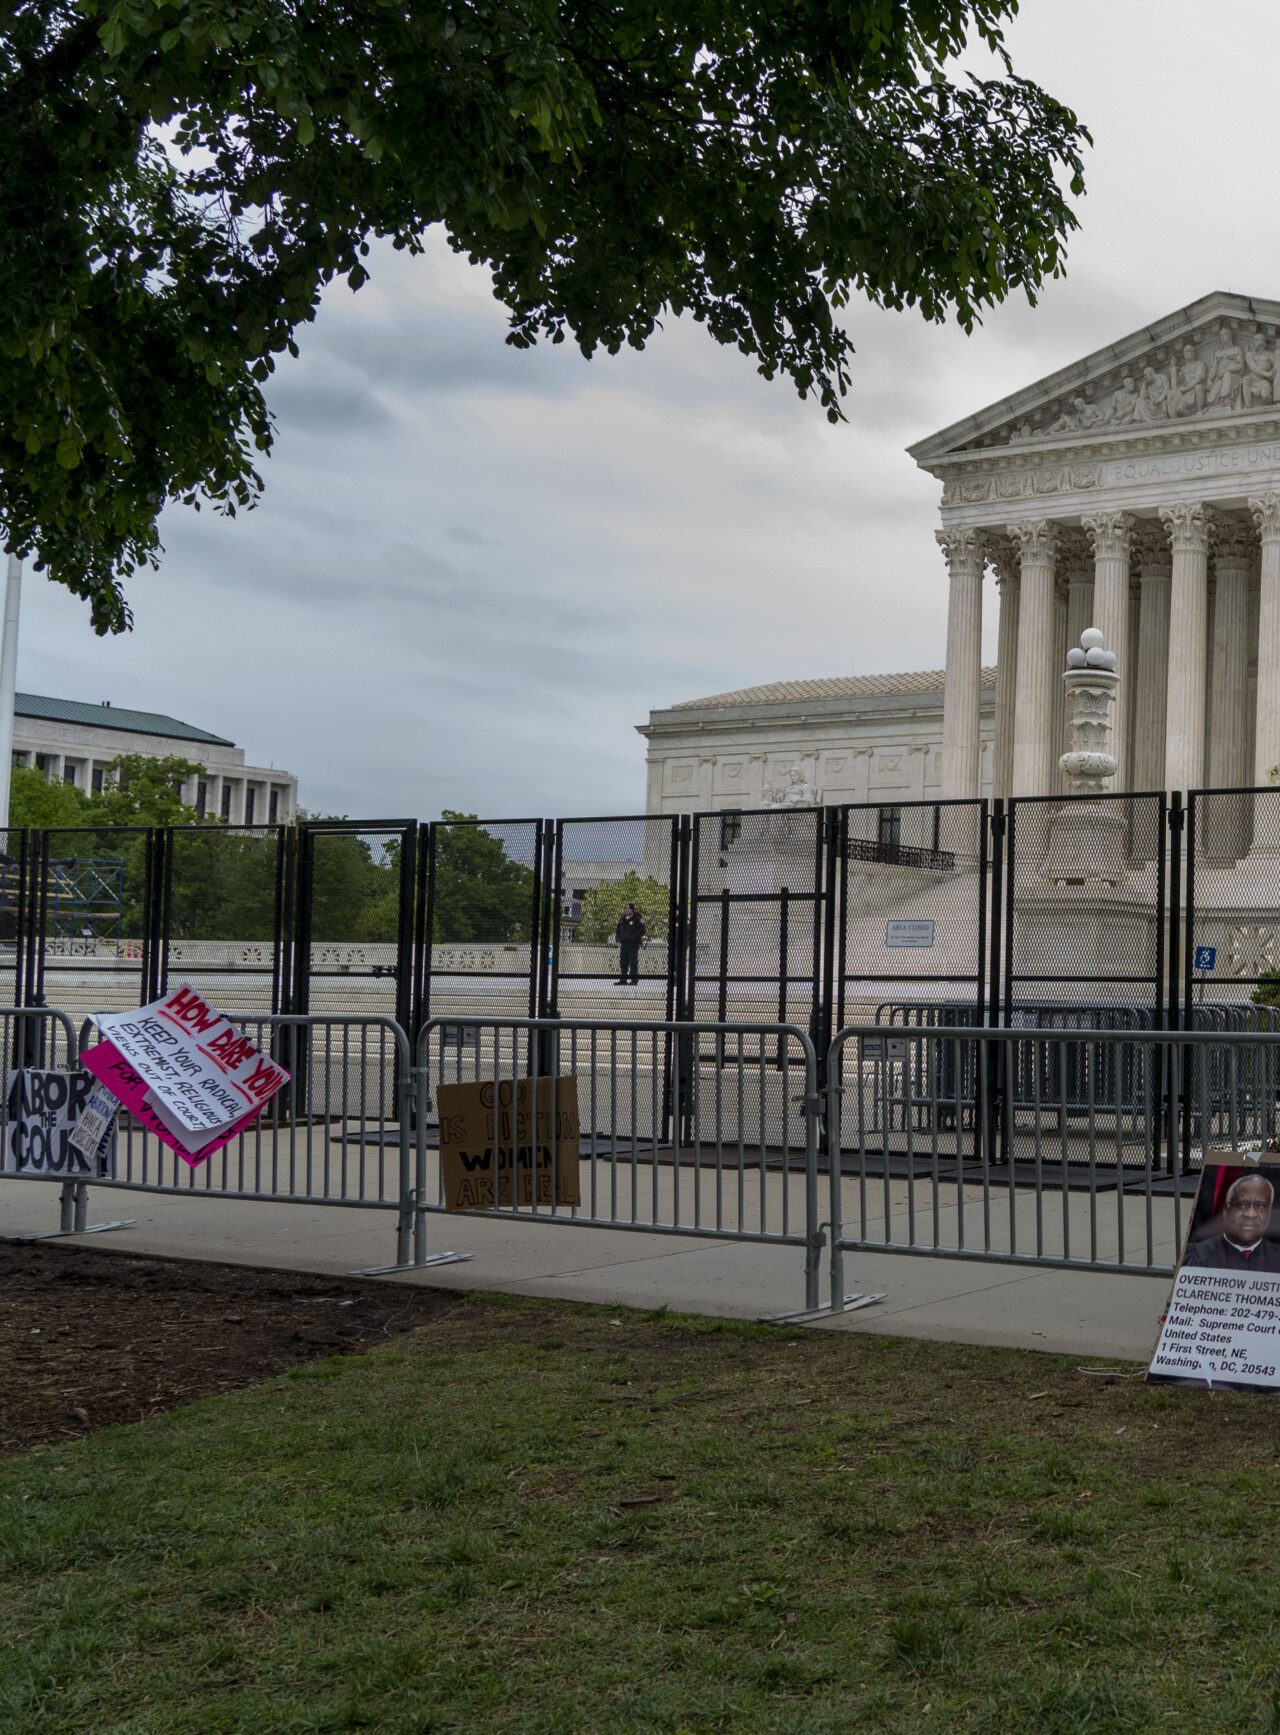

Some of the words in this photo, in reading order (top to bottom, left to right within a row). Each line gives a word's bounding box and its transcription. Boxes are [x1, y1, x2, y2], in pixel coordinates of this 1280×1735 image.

[1115, 463, 1170, 480] EQUAL
[1174, 453, 1239, 473] JUSTICE
[165, 987, 221, 1033] HOW
[206, 1027, 256, 1070] DARE
[107, 1025, 138, 1057] VIEWS
[138, 1061, 162, 1082] OUT
[158, 1085, 175, 1098] OF
[119, 1022, 181, 1081] EXTREMIST,
[174, 1081, 223, 1126] RELIGIOUS
[137, 1016, 178, 1046] KEEP
[168, 1046, 203, 1077] YOUR
[198, 1078, 243, 1119] RADICAL,
[108, 1061, 143, 1092] FOR
[8, 1070, 96, 1121] ABOR
[40, 1111, 57, 1129] THE
[441, 1115, 467, 1145] IS
[11, 1121, 108, 1171] COUR
[459, 1145, 553, 1172] WOMEN
[456, 1176, 510, 1207] ARE
[1176, 1288, 1232, 1303] CLARENCE
[1179, 1274, 1247, 1290] OVERTHROW
[1174, 1302, 1228, 1316] Telephone:
[1164, 1328, 1198, 1341] United
[1198, 1332, 1232, 1344] States
[1168, 1315, 1194, 1327] Mail:
[1198, 1318, 1245, 1331] Supreme
[1246, 1322, 1276, 1335] Court
[1162, 1342, 1167, 1352] 1
[1169, 1342, 1192, 1354] First
[1195, 1344, 1228, 1359] Street,
[1230, 1348, 1248, 1361] NE,
[1156, 1355, 1217, 1372] Washingn,
[1220, 1360, 1238, 1374] DC,
[1240, 1363, 1276, 1376] 20543
